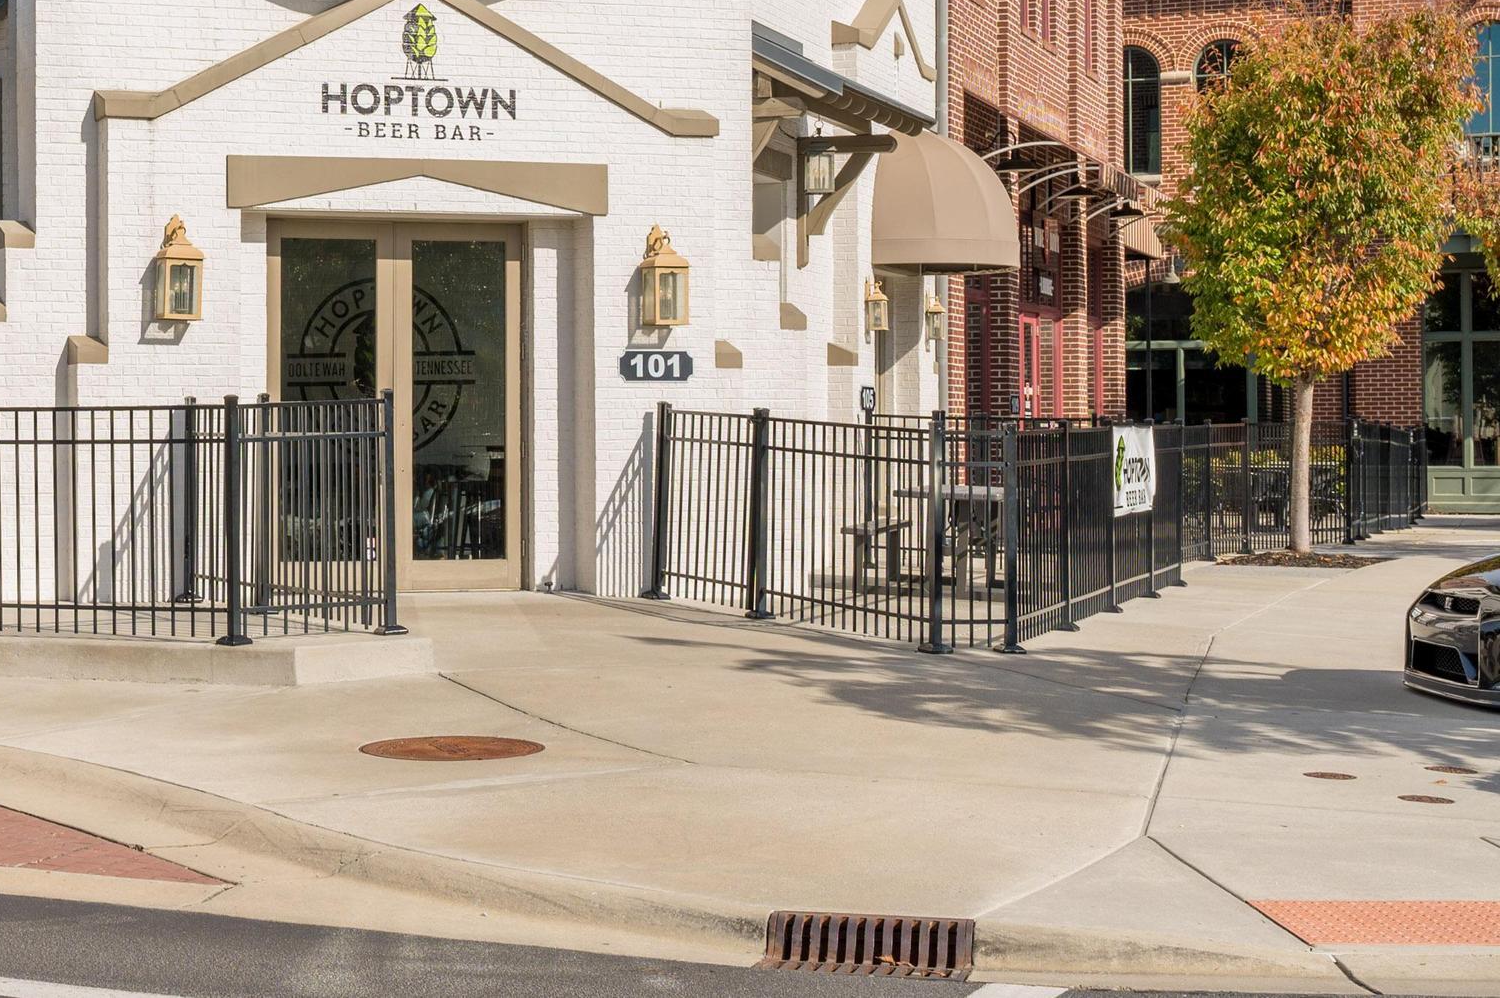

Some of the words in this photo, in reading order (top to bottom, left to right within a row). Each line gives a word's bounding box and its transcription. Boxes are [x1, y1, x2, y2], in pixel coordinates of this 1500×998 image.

[322, 83, 517, 120] HOPTOWN
[288, 362, 346, 378] OOLTEWAH
[416, 360, 473, 376] TENNESSEE
[630, 354, 680, 378] 101
[863, 389, 874, 409] 105
